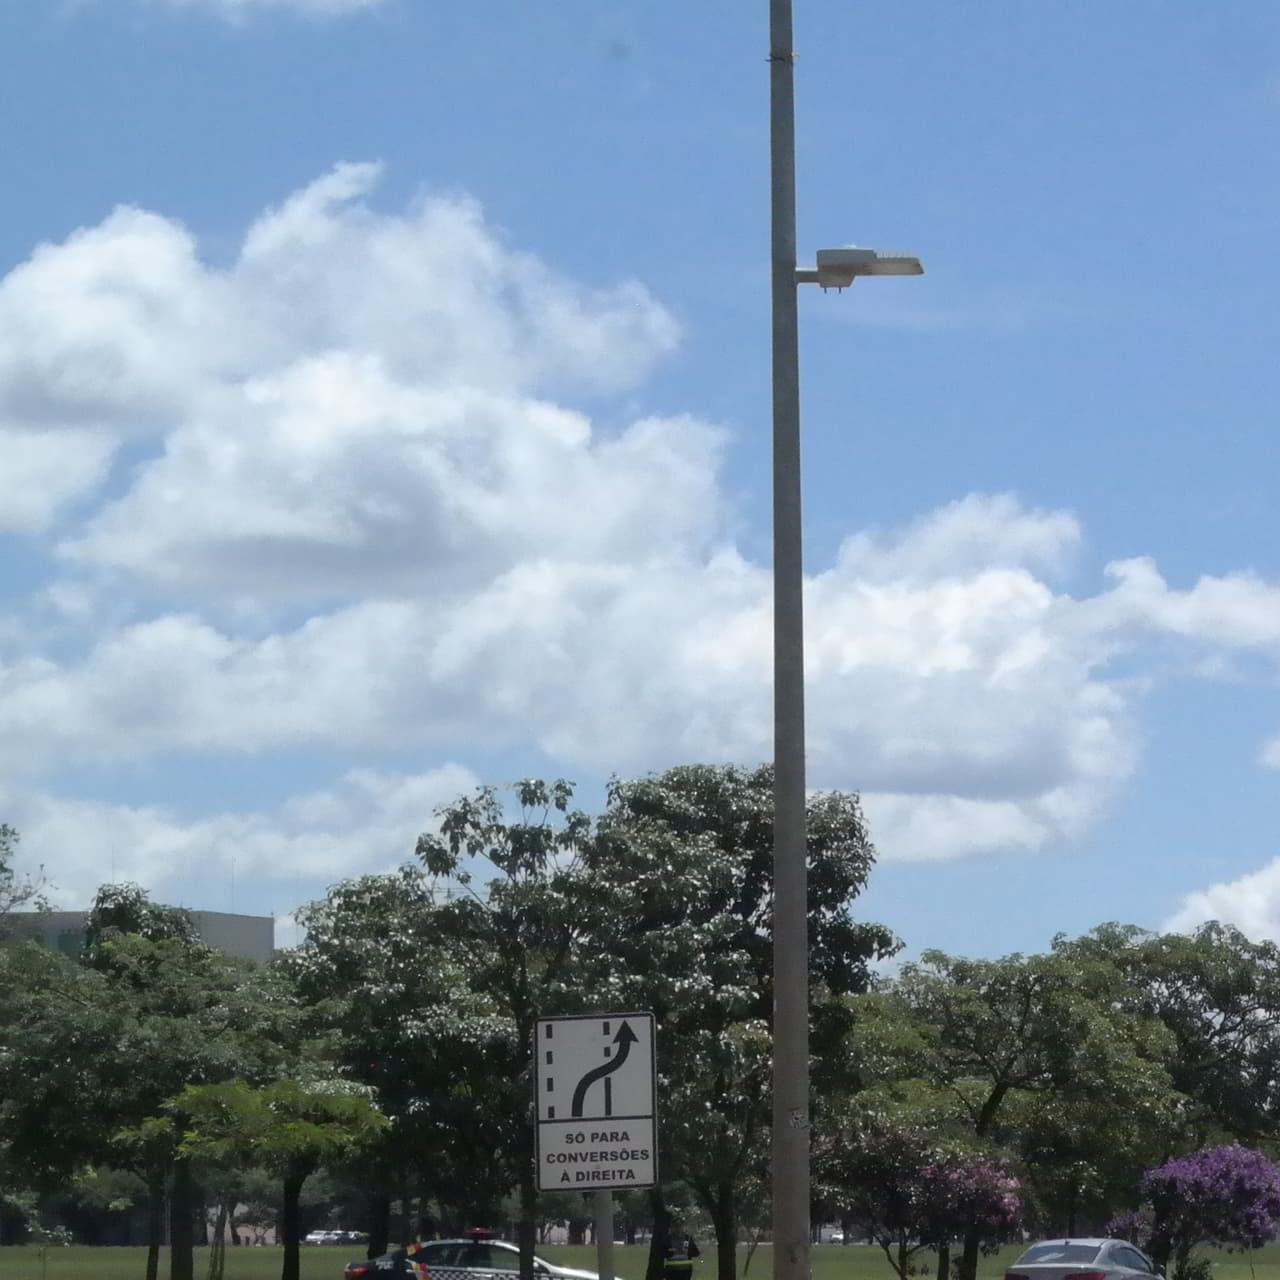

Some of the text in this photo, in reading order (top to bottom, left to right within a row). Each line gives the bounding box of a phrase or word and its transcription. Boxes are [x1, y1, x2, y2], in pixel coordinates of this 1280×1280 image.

[565, 1131, 630, 1144] SÓ PARA
[546, 1148, 649, 1164] CONVERSÕES
[575, 1169, 636, 1182] DIREITA
